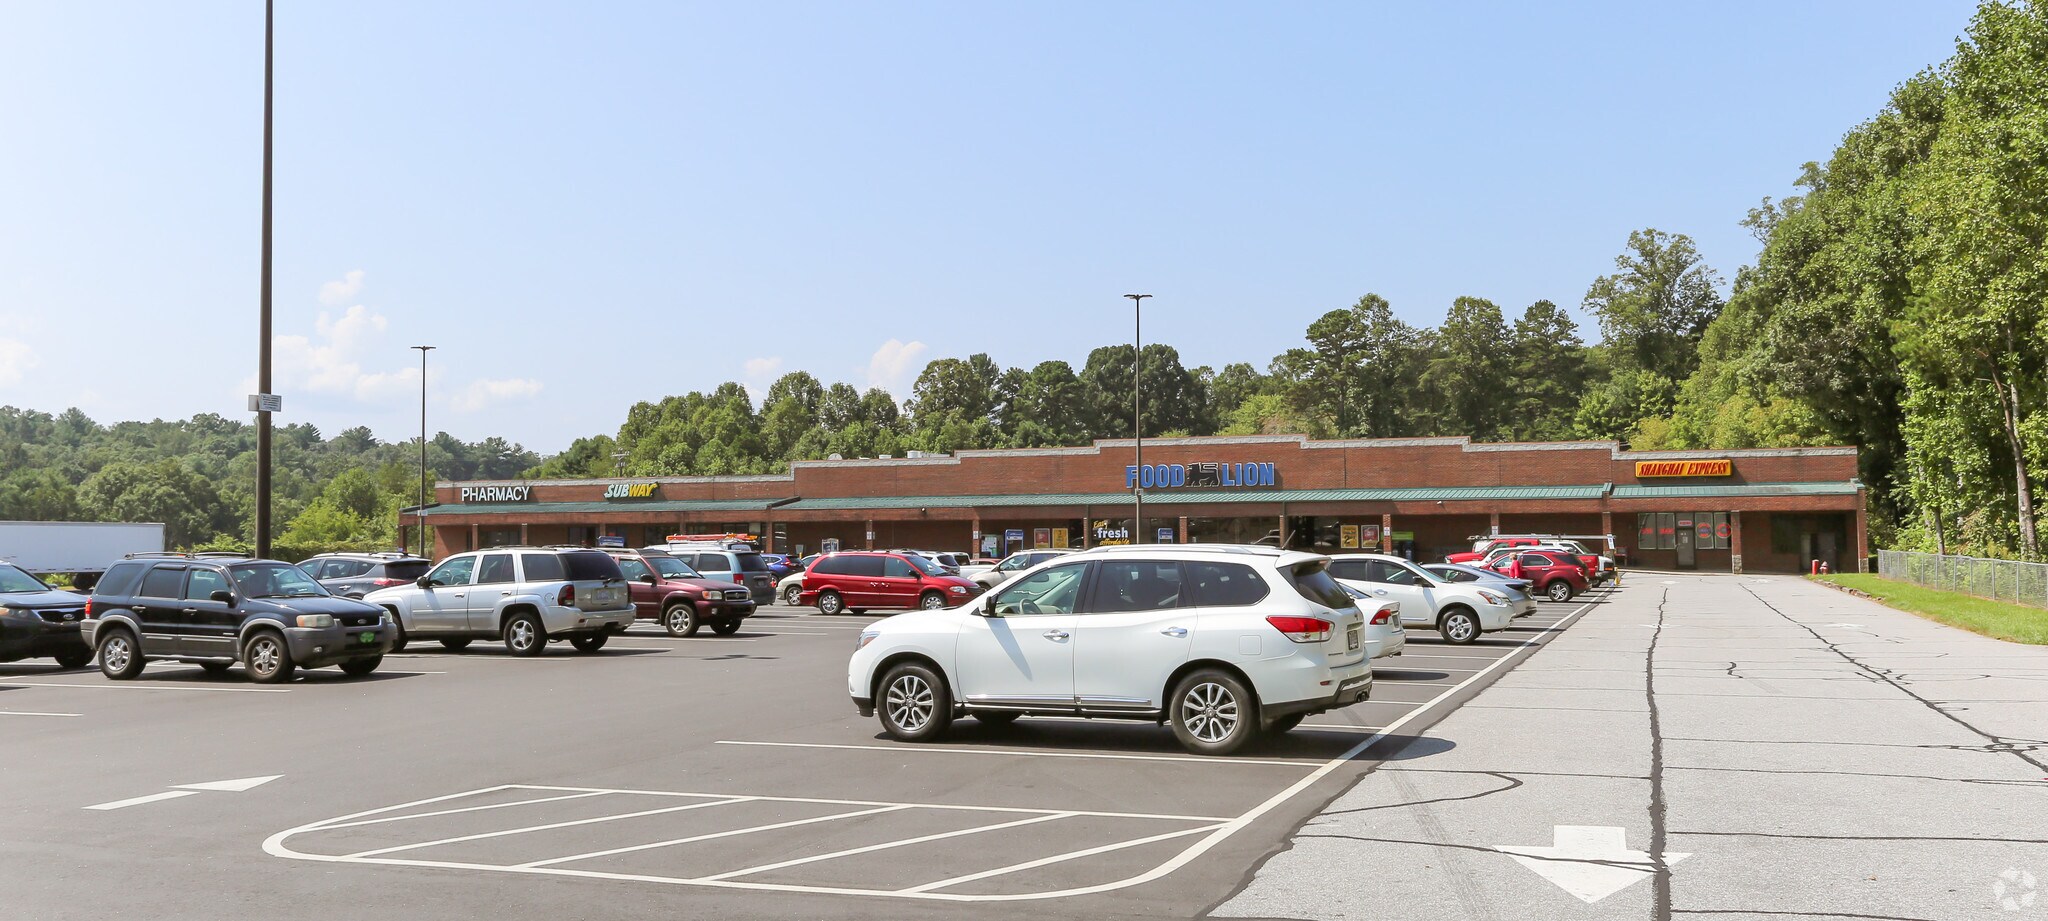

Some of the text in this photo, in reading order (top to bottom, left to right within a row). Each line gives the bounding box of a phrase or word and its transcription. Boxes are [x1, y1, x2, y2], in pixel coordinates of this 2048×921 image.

[1125, 462, 1275, 488] FOOD LION
[1639, 462, 1729, 476] SHANGHAI EXPRESS
[461, 486, 530, 501] PHARMACY
[604, 481, 659, 498] SUBWAY
[1097, 527, 1129, 538] fresh
